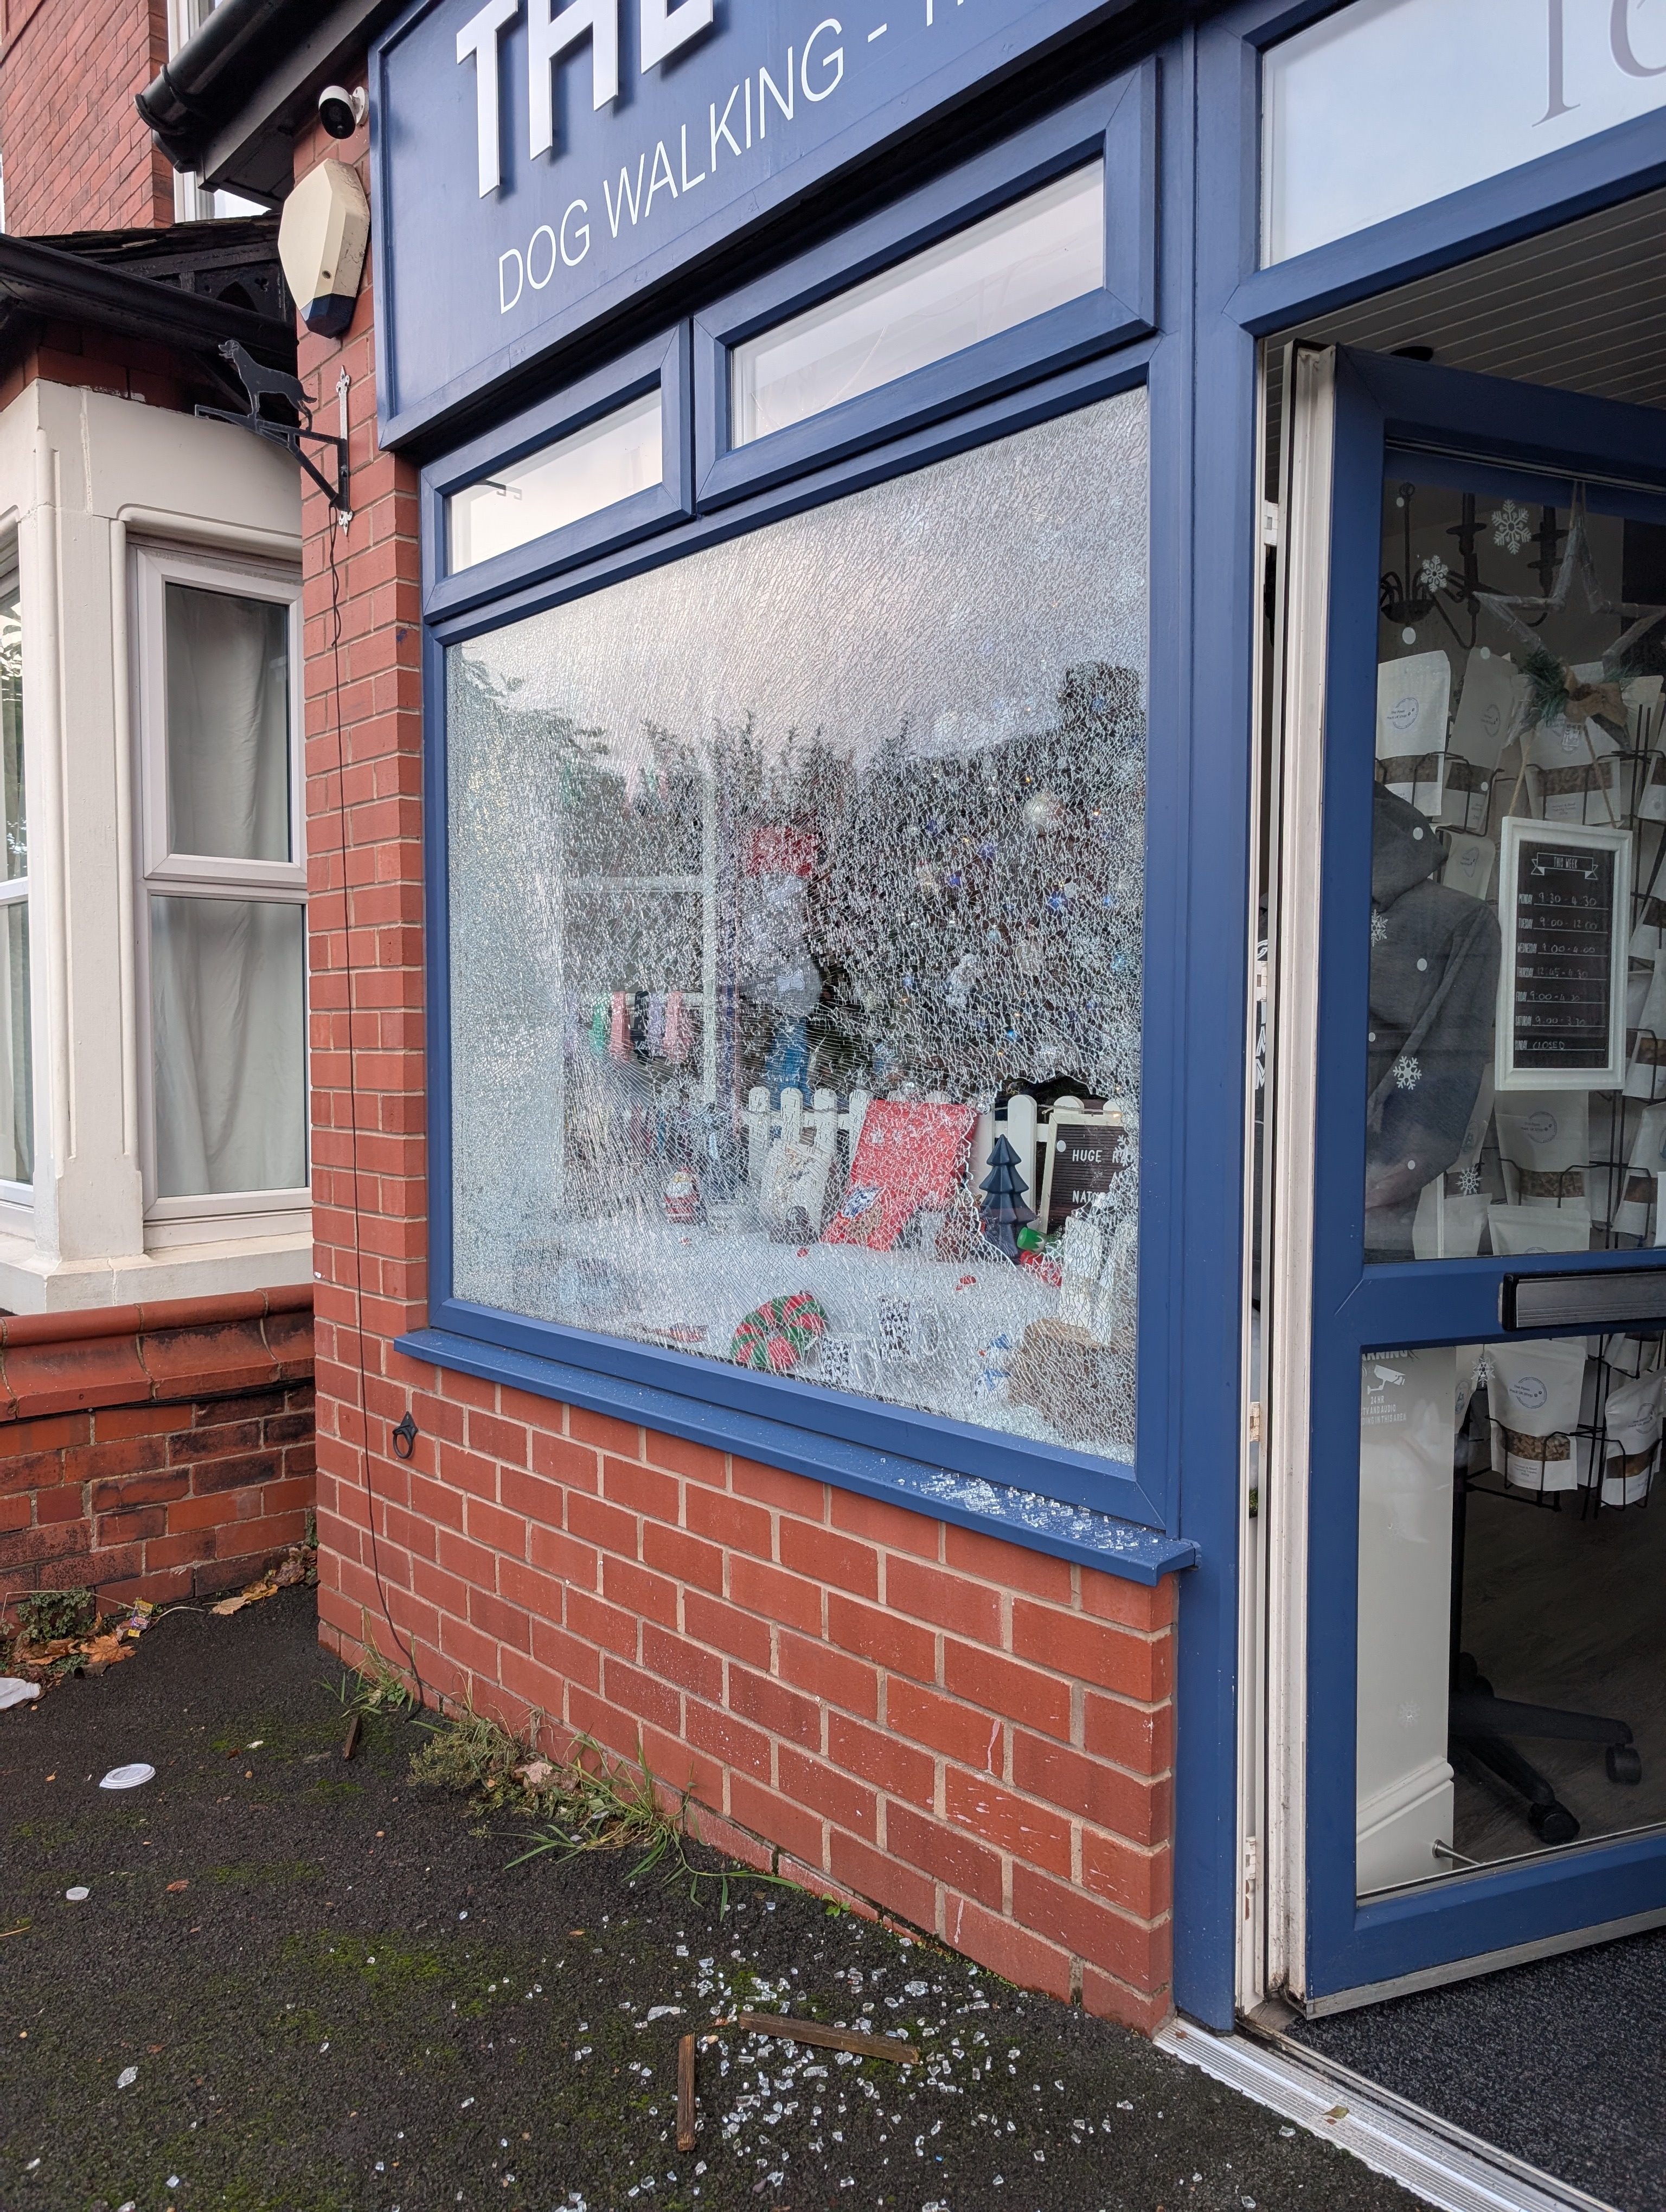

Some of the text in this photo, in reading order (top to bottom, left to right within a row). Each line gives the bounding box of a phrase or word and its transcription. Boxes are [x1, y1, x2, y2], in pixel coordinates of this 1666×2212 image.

[499, 198, 590, 314] DOG
[603, 18, 843, 239] WALKING
[1566, 858, 1578, 869] WEEK
[1533, 1040, 1565, 1050] CLOSED
[1072, 1149, 1103, 1162] HUGE
[1370, 1395, 1385, 1405] 24 HR
[1370, 1406, 1380, 1414] AND
[1381, 1404, 1396, 1413] AUDIO
[1381, 1414, 1393, 1423] THIS
[1393, 1413, 1406, 1422] AREA
